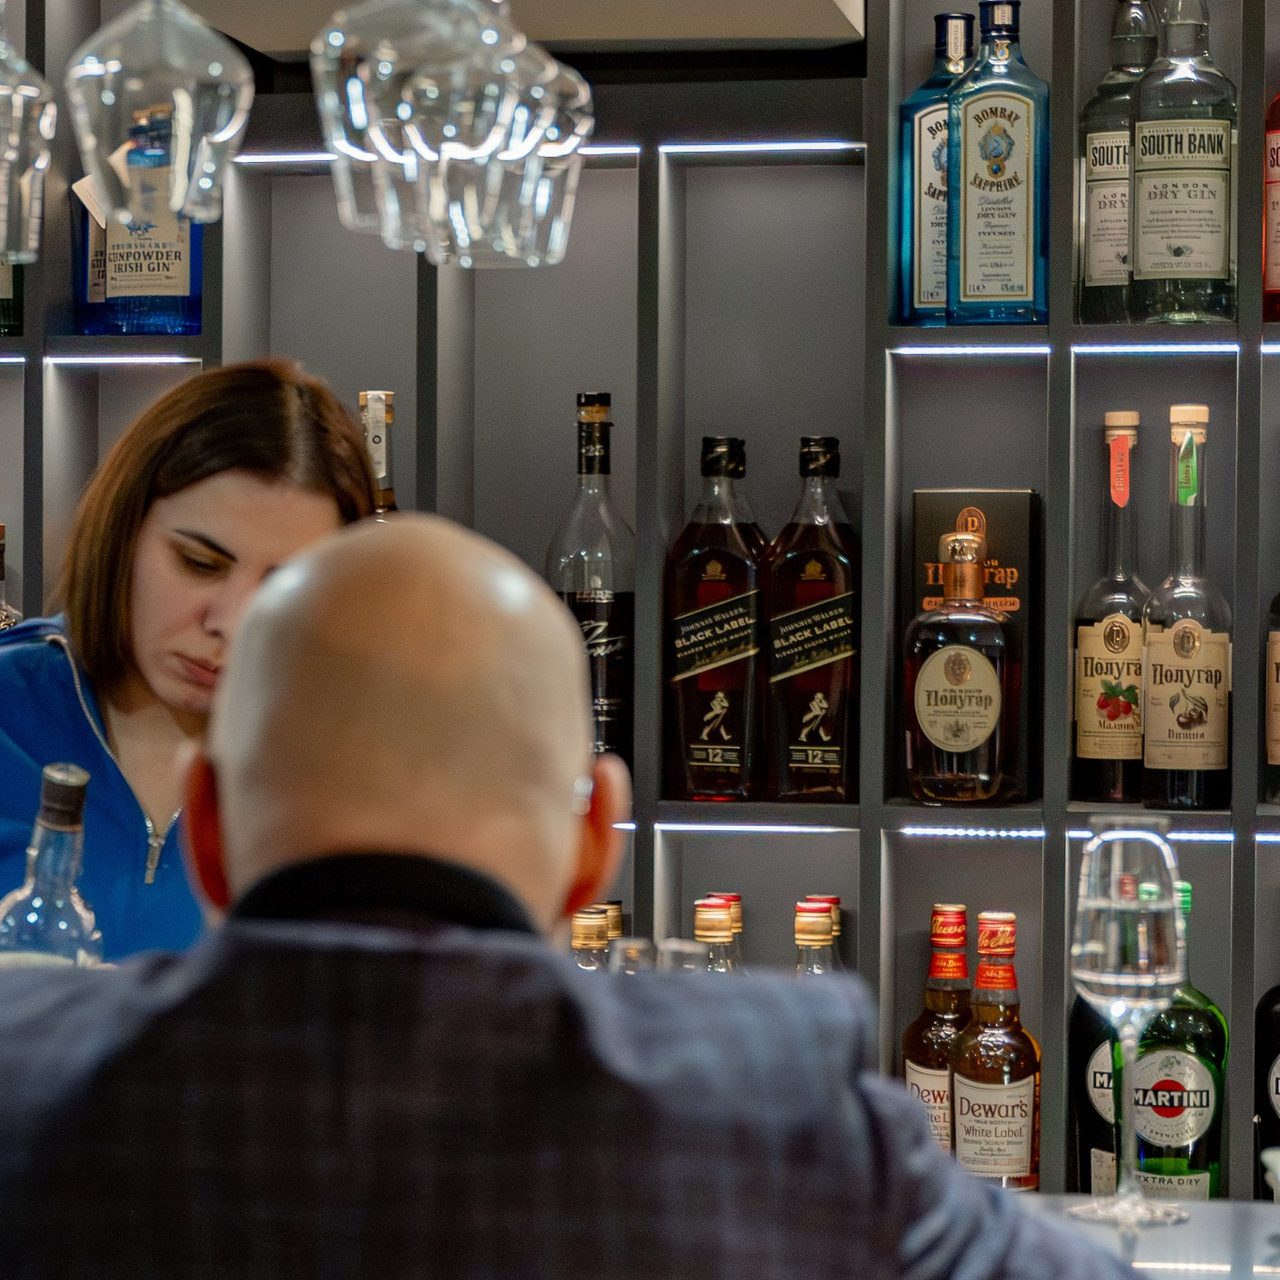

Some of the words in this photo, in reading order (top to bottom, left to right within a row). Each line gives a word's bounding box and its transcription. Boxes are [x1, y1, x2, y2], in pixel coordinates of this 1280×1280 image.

[973, 106, 1021, 126] BOMBAY
[1141, 133, 1184, 157] SOUTH
[1187, 133, 1224, 155] BANK
[970, 171, 1023, 192] SAPPHIRE
[1147, 190, 1181, 200] DRY
[1187, 190, 1217, 200] GIN
[108, 250, 182, 263] GUNPOWDER
[114, 261, 143, 273] IRISH
[147, 261, 171, 272] GIN
[674, 629, 714, 648] BLACK
[715, 616, 757, 634] LABEL
[773, 628, 812, 649] BLACK
[814, 615, 853, 635] LABEL
[1151, 663, 1222, 689] Полугар
[924, 688, 993, 710] Полугар
[707, 749, 723, 762] 12
[806, 750, 823, 763] 12
[959, 1096, 1028, 1118] Dewar's
[1134, 1090, 1208, 1108] MARTINI
[1177, 1176, 1200, 1186] DRY
